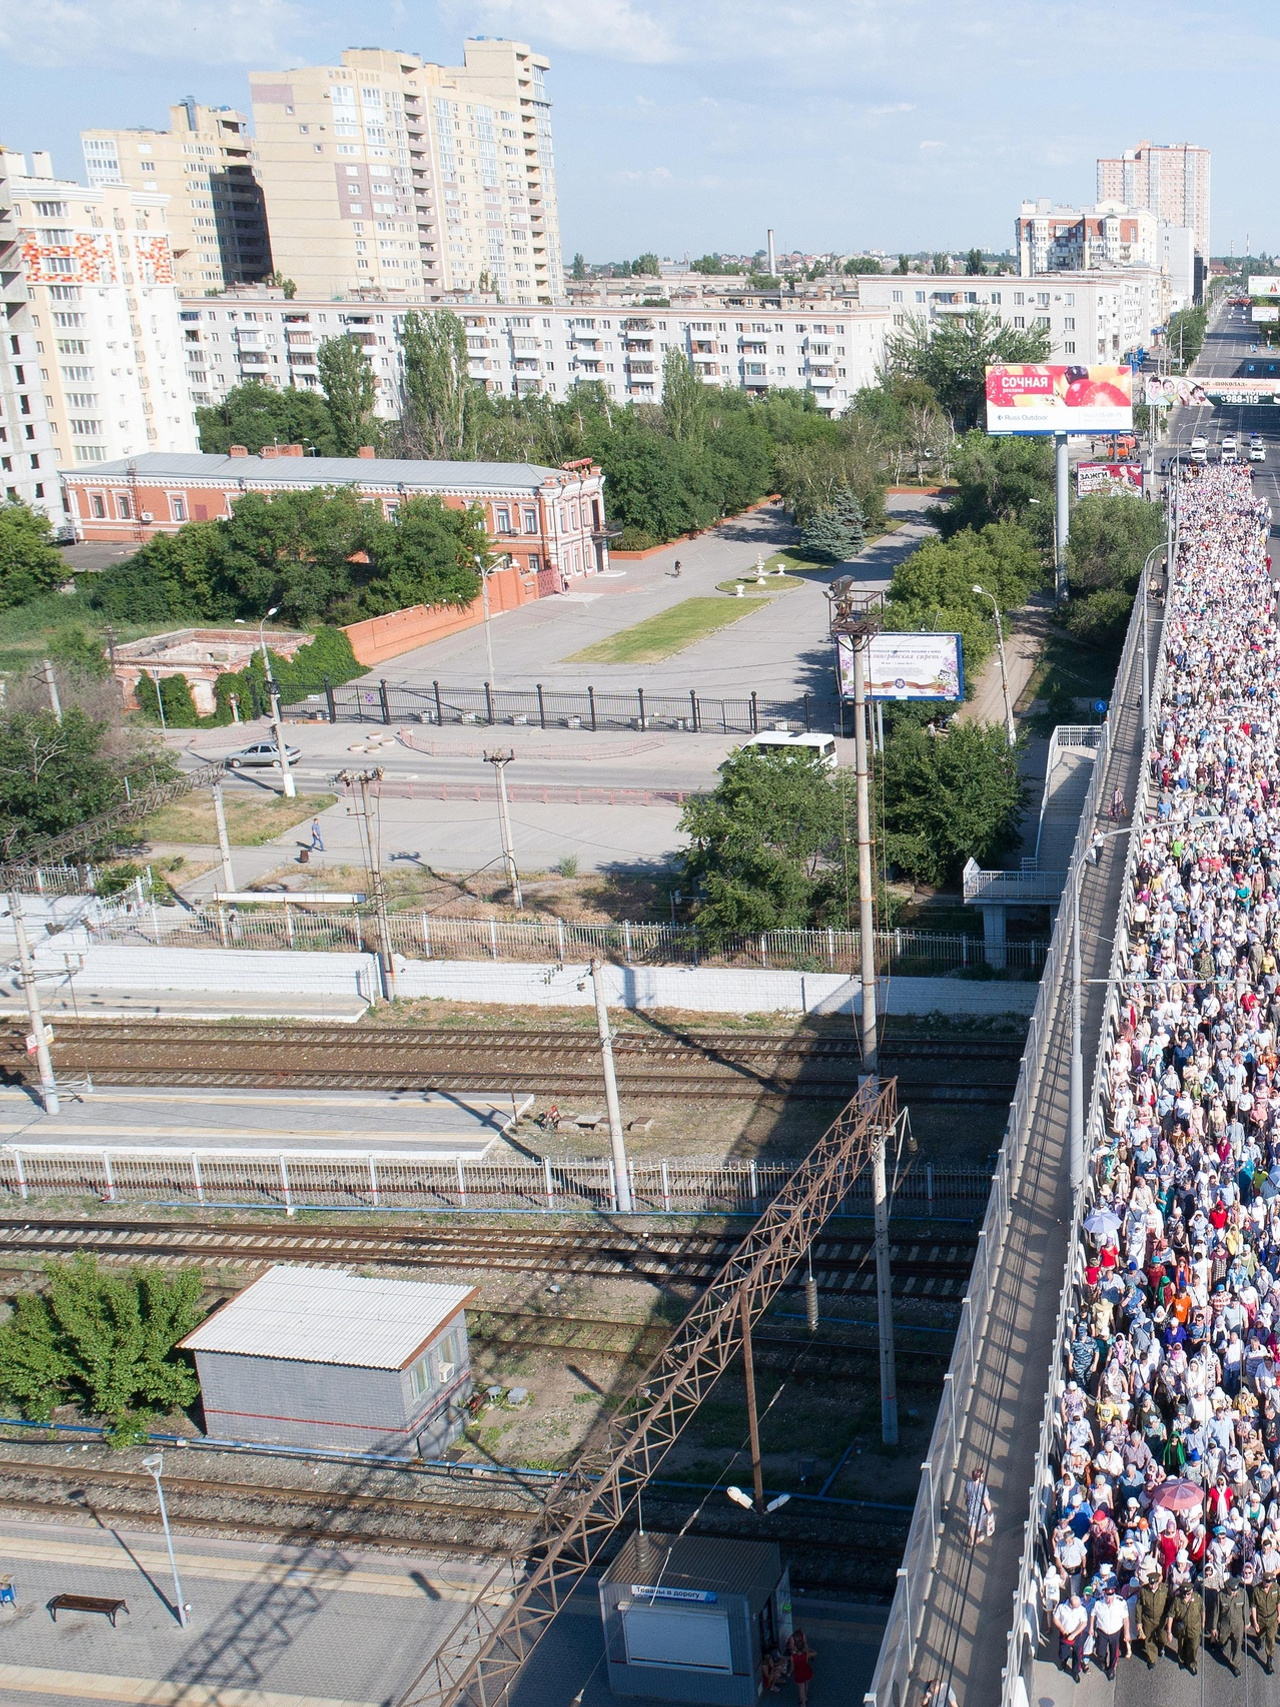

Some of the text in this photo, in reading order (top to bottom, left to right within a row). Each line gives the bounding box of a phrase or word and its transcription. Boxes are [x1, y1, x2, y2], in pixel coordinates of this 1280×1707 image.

[1002, 376, 1048, 388] СОЧНАЯ
[1226, 395, 1260, 404] 988-115
[1080, 472, 1108, 480] ЗАЖГИ
